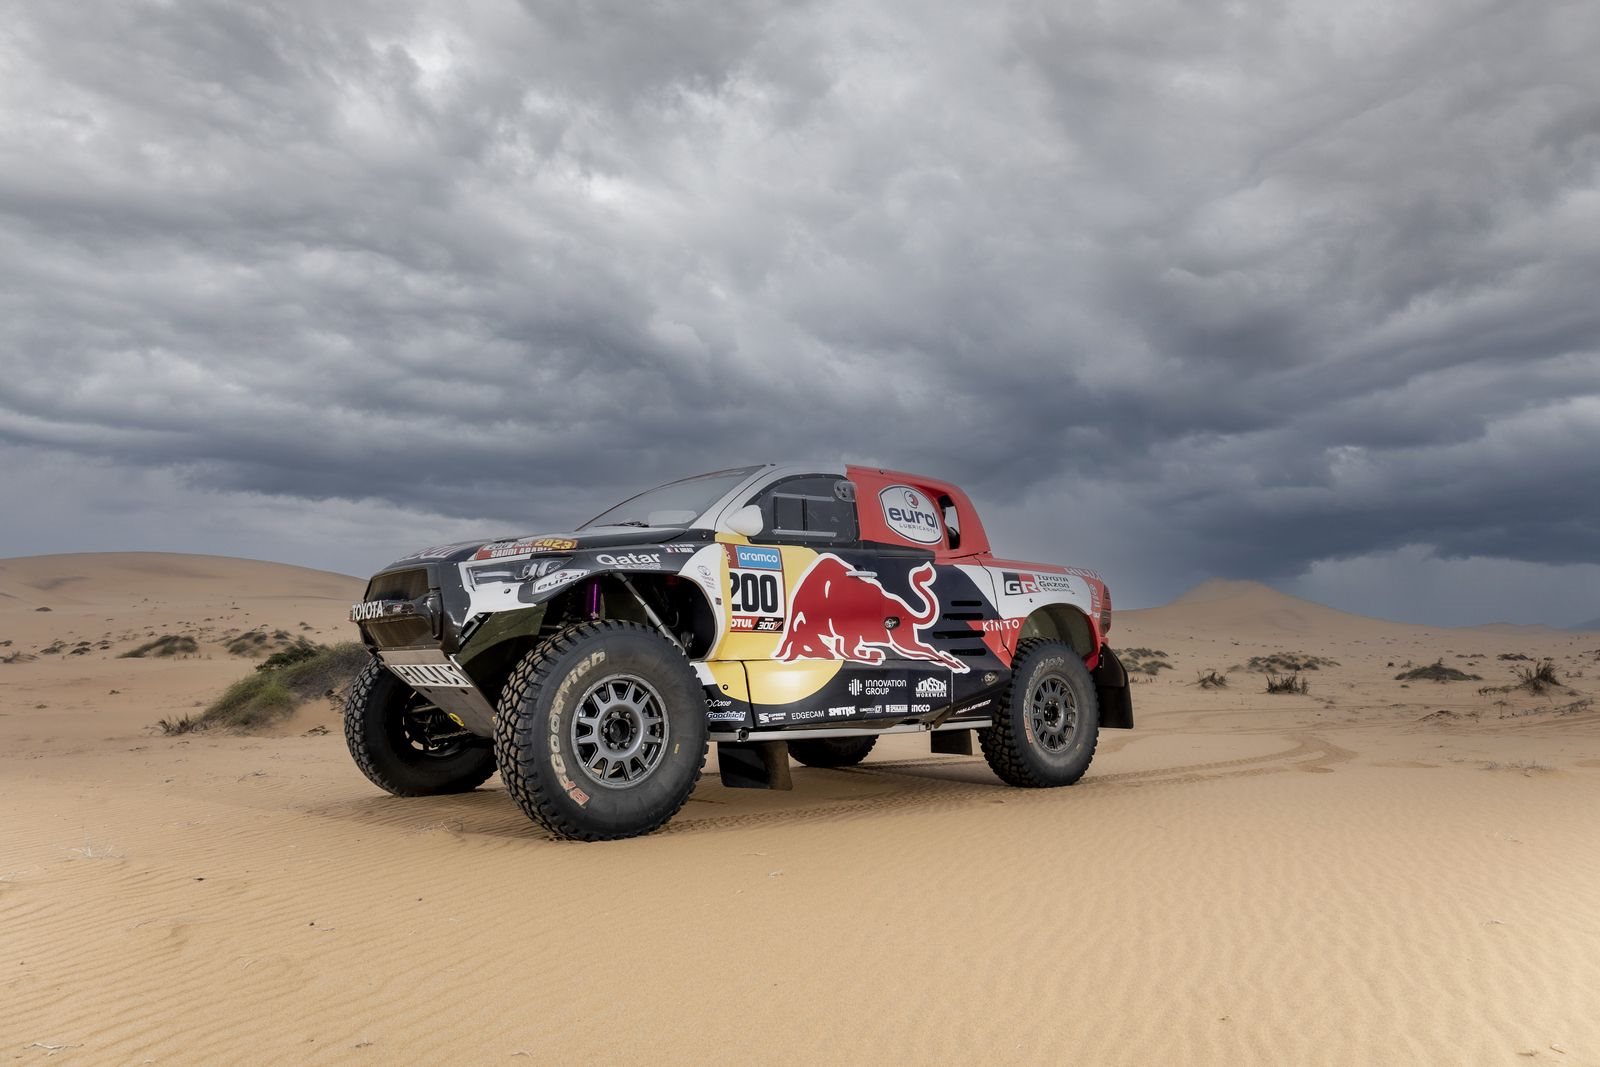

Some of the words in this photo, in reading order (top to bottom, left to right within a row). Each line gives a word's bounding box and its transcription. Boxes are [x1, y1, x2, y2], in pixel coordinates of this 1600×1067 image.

[888, 507, 938, 530] eurol
[596, 553, 660, 565] Qatar
[740, 552, 778, 564] aramco
[729, 572, 778, 613] 200
[352, 600, 384, 621] TOYOTA
[391, 665, 471, 687] HILUX
[865, 687, 890, 696] GROUP
[915, 677, 947, 692] JONSSON
[791, 710, 825, 720] EDGECAM
